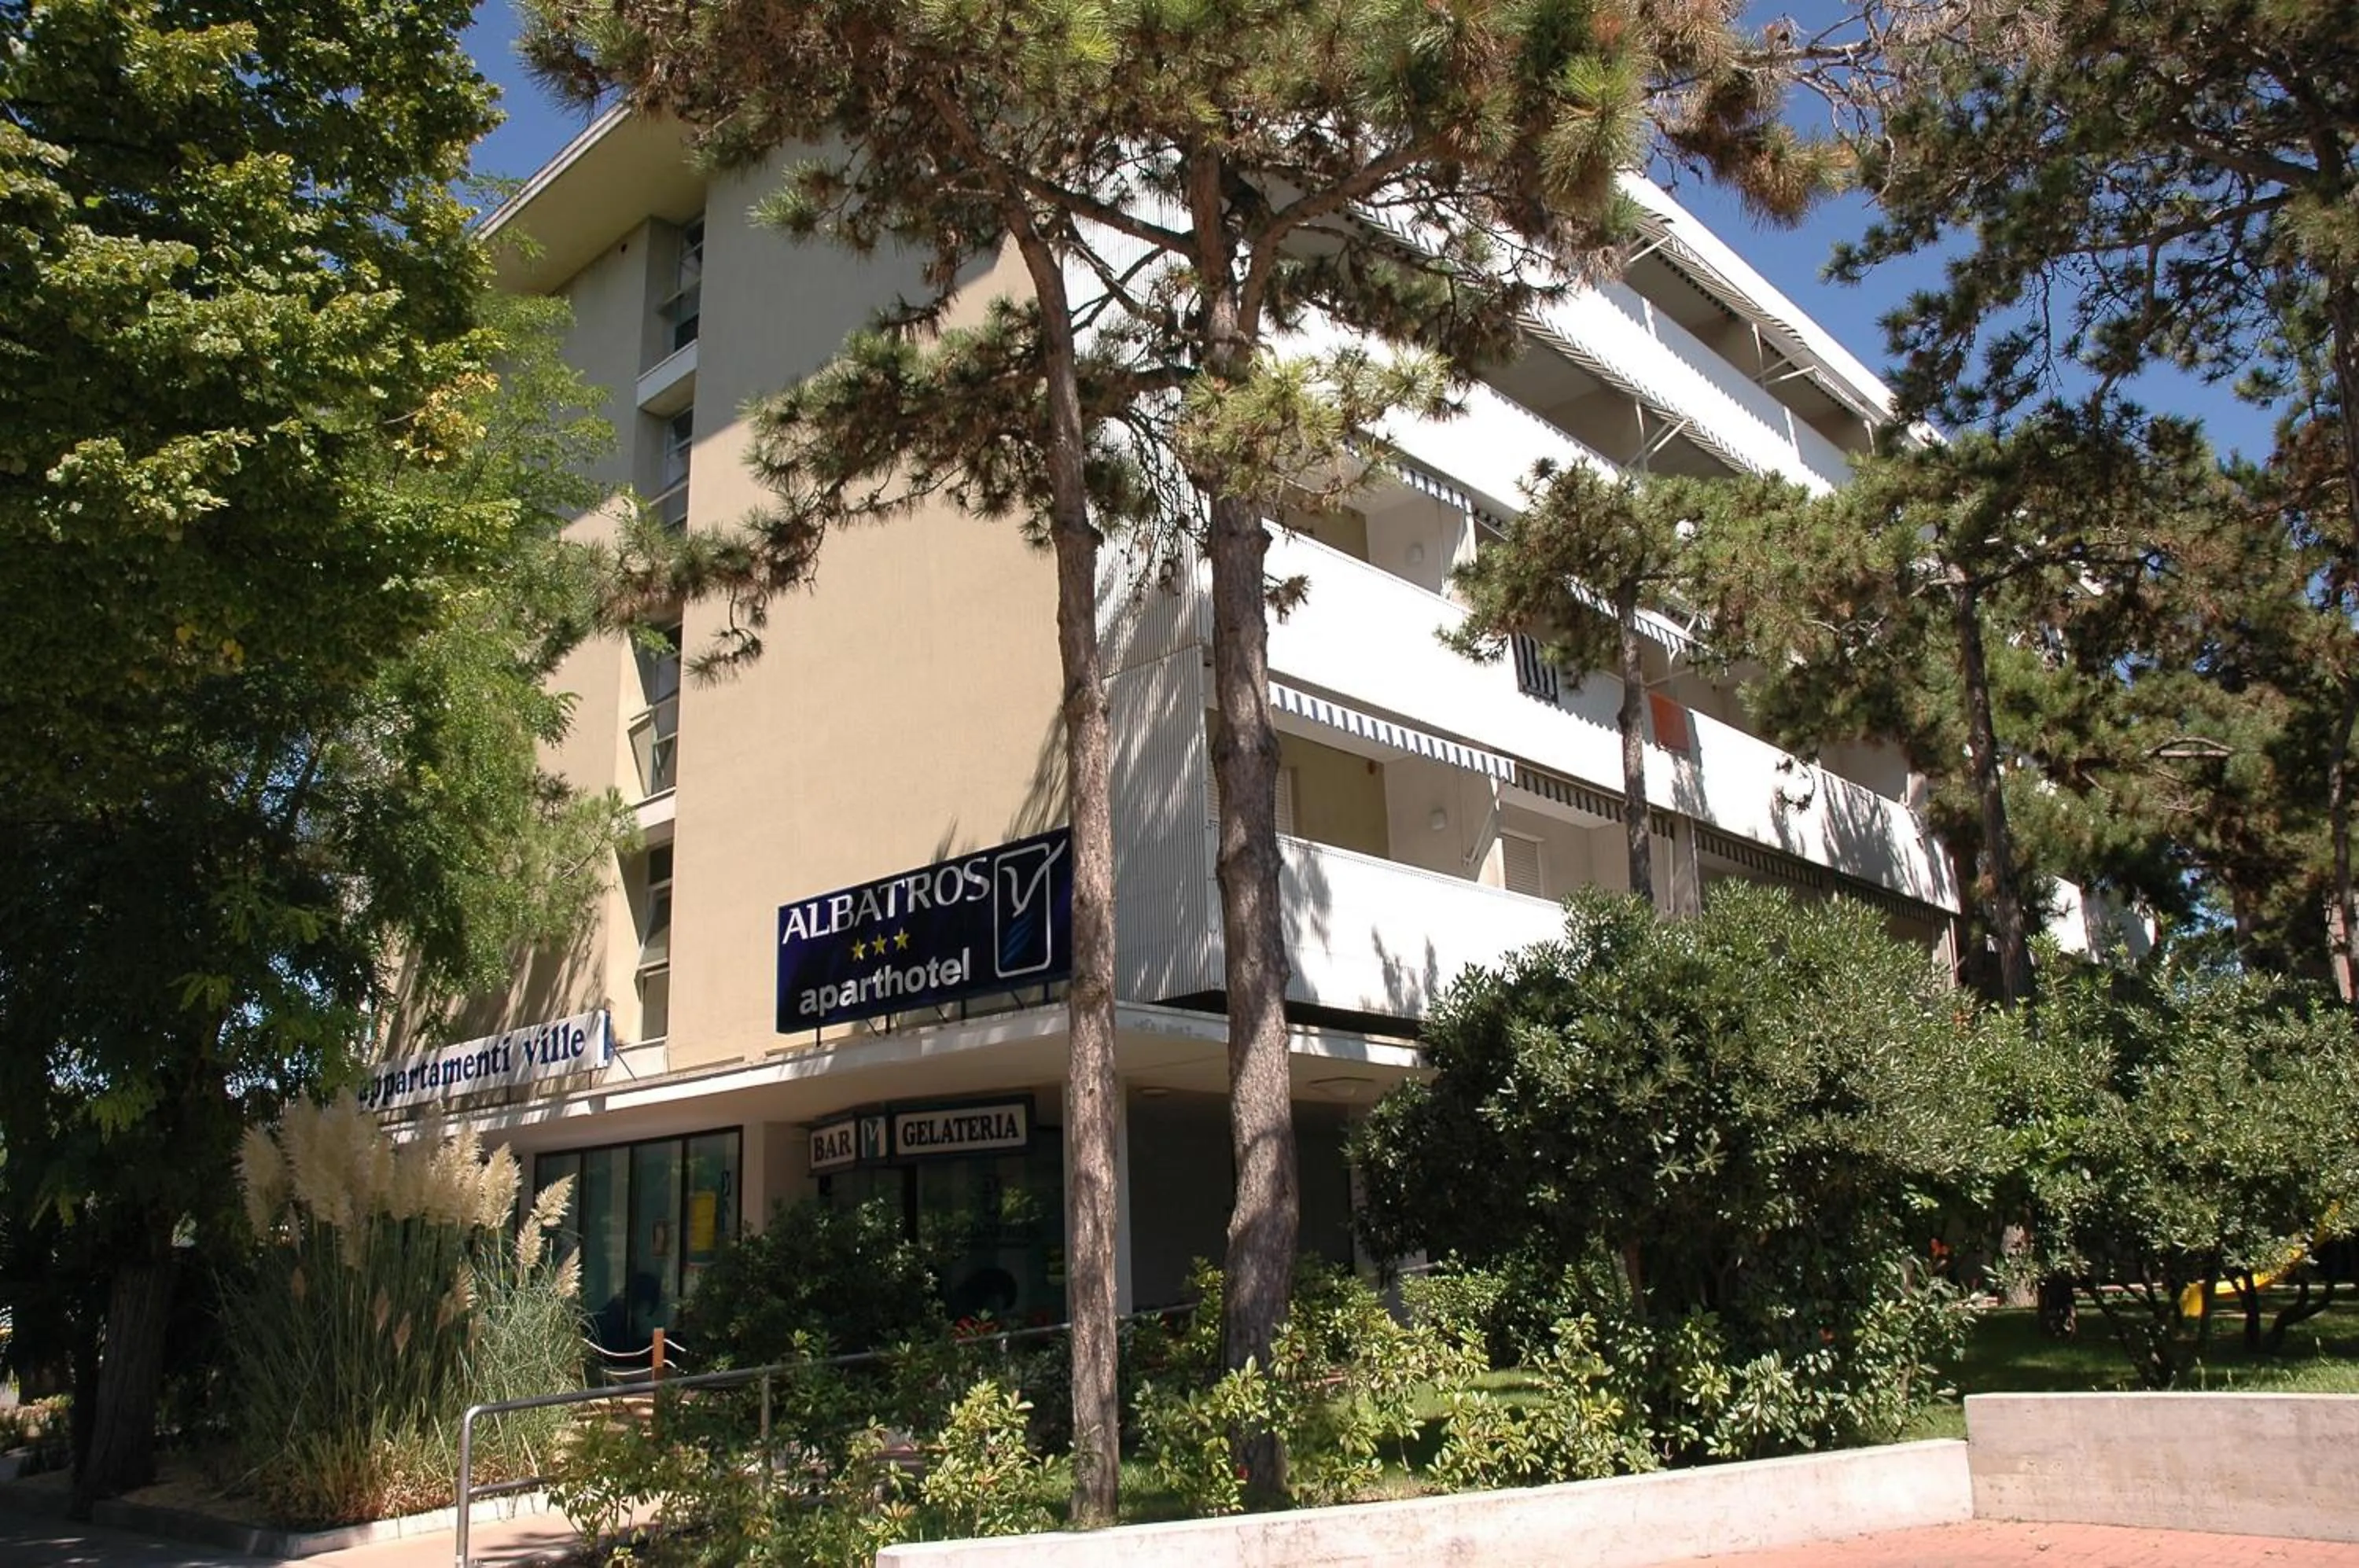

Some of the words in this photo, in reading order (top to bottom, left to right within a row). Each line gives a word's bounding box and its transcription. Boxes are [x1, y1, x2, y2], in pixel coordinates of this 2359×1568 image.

[782, 856, 990, 944] ALBATROS
[799, 947, 970, 1017] aparthotel
[523, 1022, 585, 1065] ville
[813, 1129, 852, 1162] BAR
[902, 1112, 1019, 1147] GELATERIA
